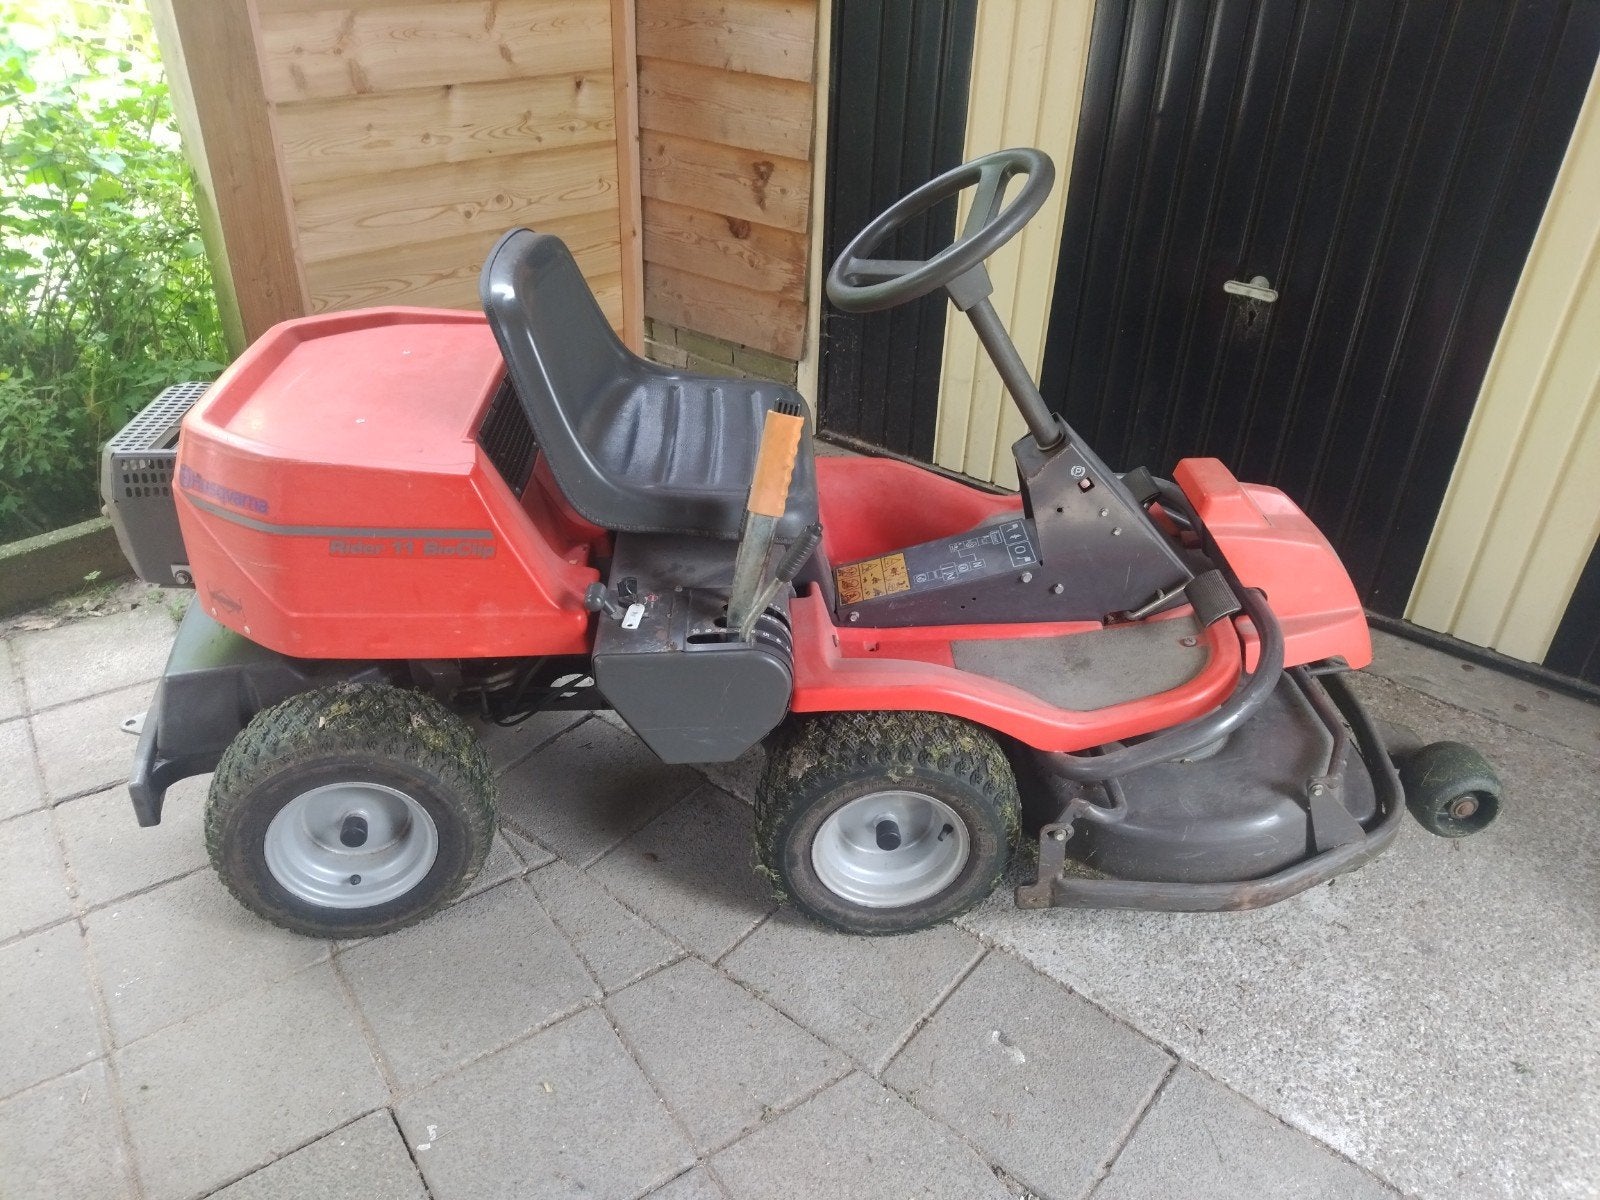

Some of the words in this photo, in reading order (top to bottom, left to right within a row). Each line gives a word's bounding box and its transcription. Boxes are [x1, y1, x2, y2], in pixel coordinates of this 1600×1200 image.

[329, 539, 383, 555] Rider
[393, 540, 415, 555] 11
[423, 541, 495, 559] BioClip
